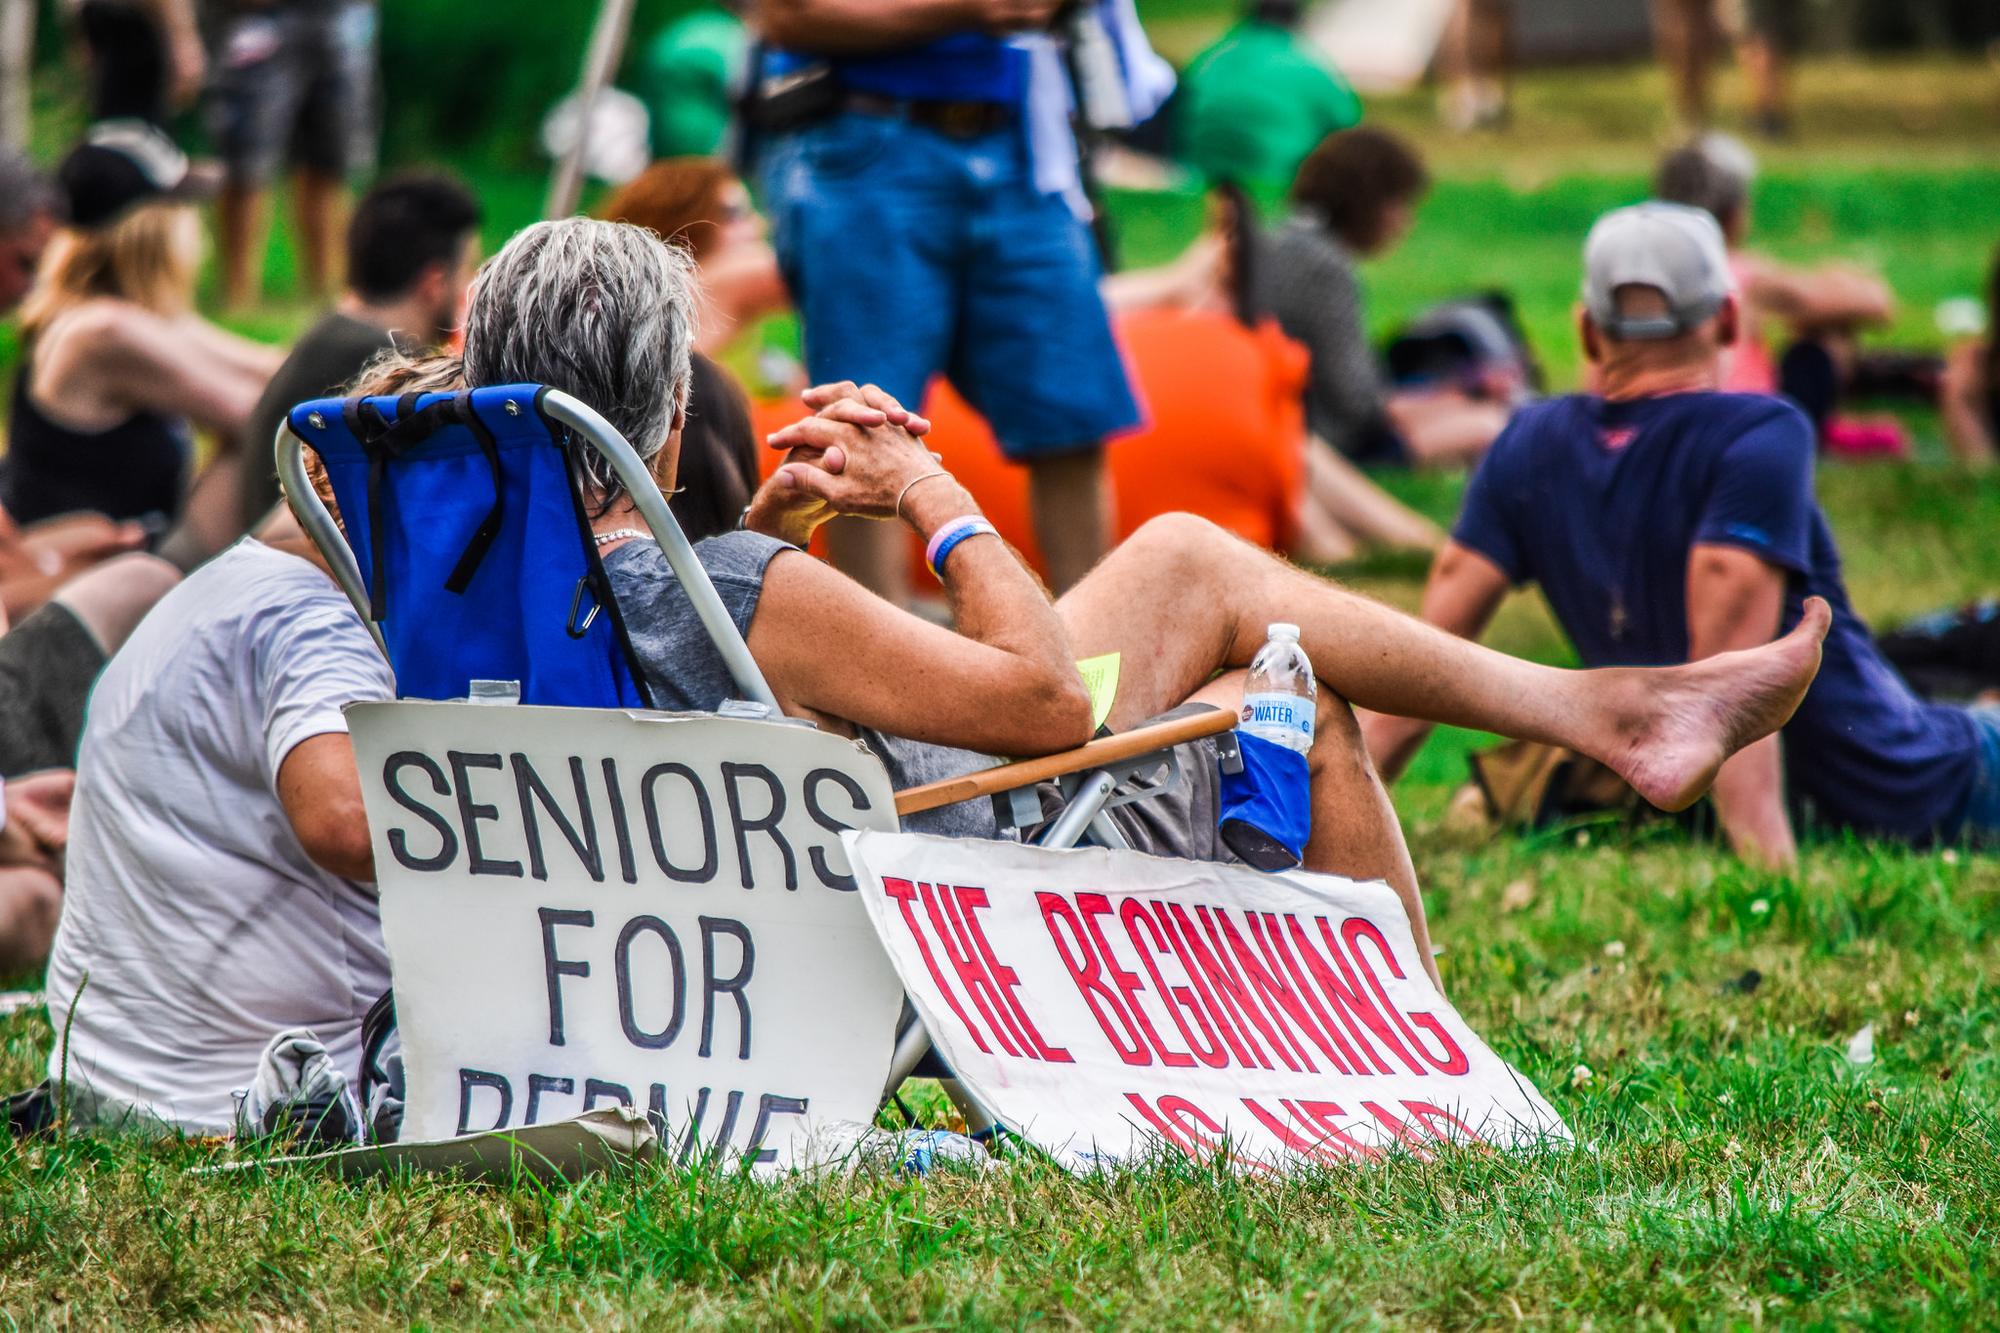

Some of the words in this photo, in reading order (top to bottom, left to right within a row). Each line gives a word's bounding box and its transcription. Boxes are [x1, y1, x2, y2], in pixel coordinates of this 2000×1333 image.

[1255, 706, 1293, 723] WATER
[383, 751, 871, 891] SENIORS
[538, 907, 756, 1060] FOR
[881, 876, 1077, 1063] THE
[1035, 891, 1471, 1076] BEGINNING
[456, 1068, 809, 1164] BNIE
[1123, 1093, 1286, 1175] IS
